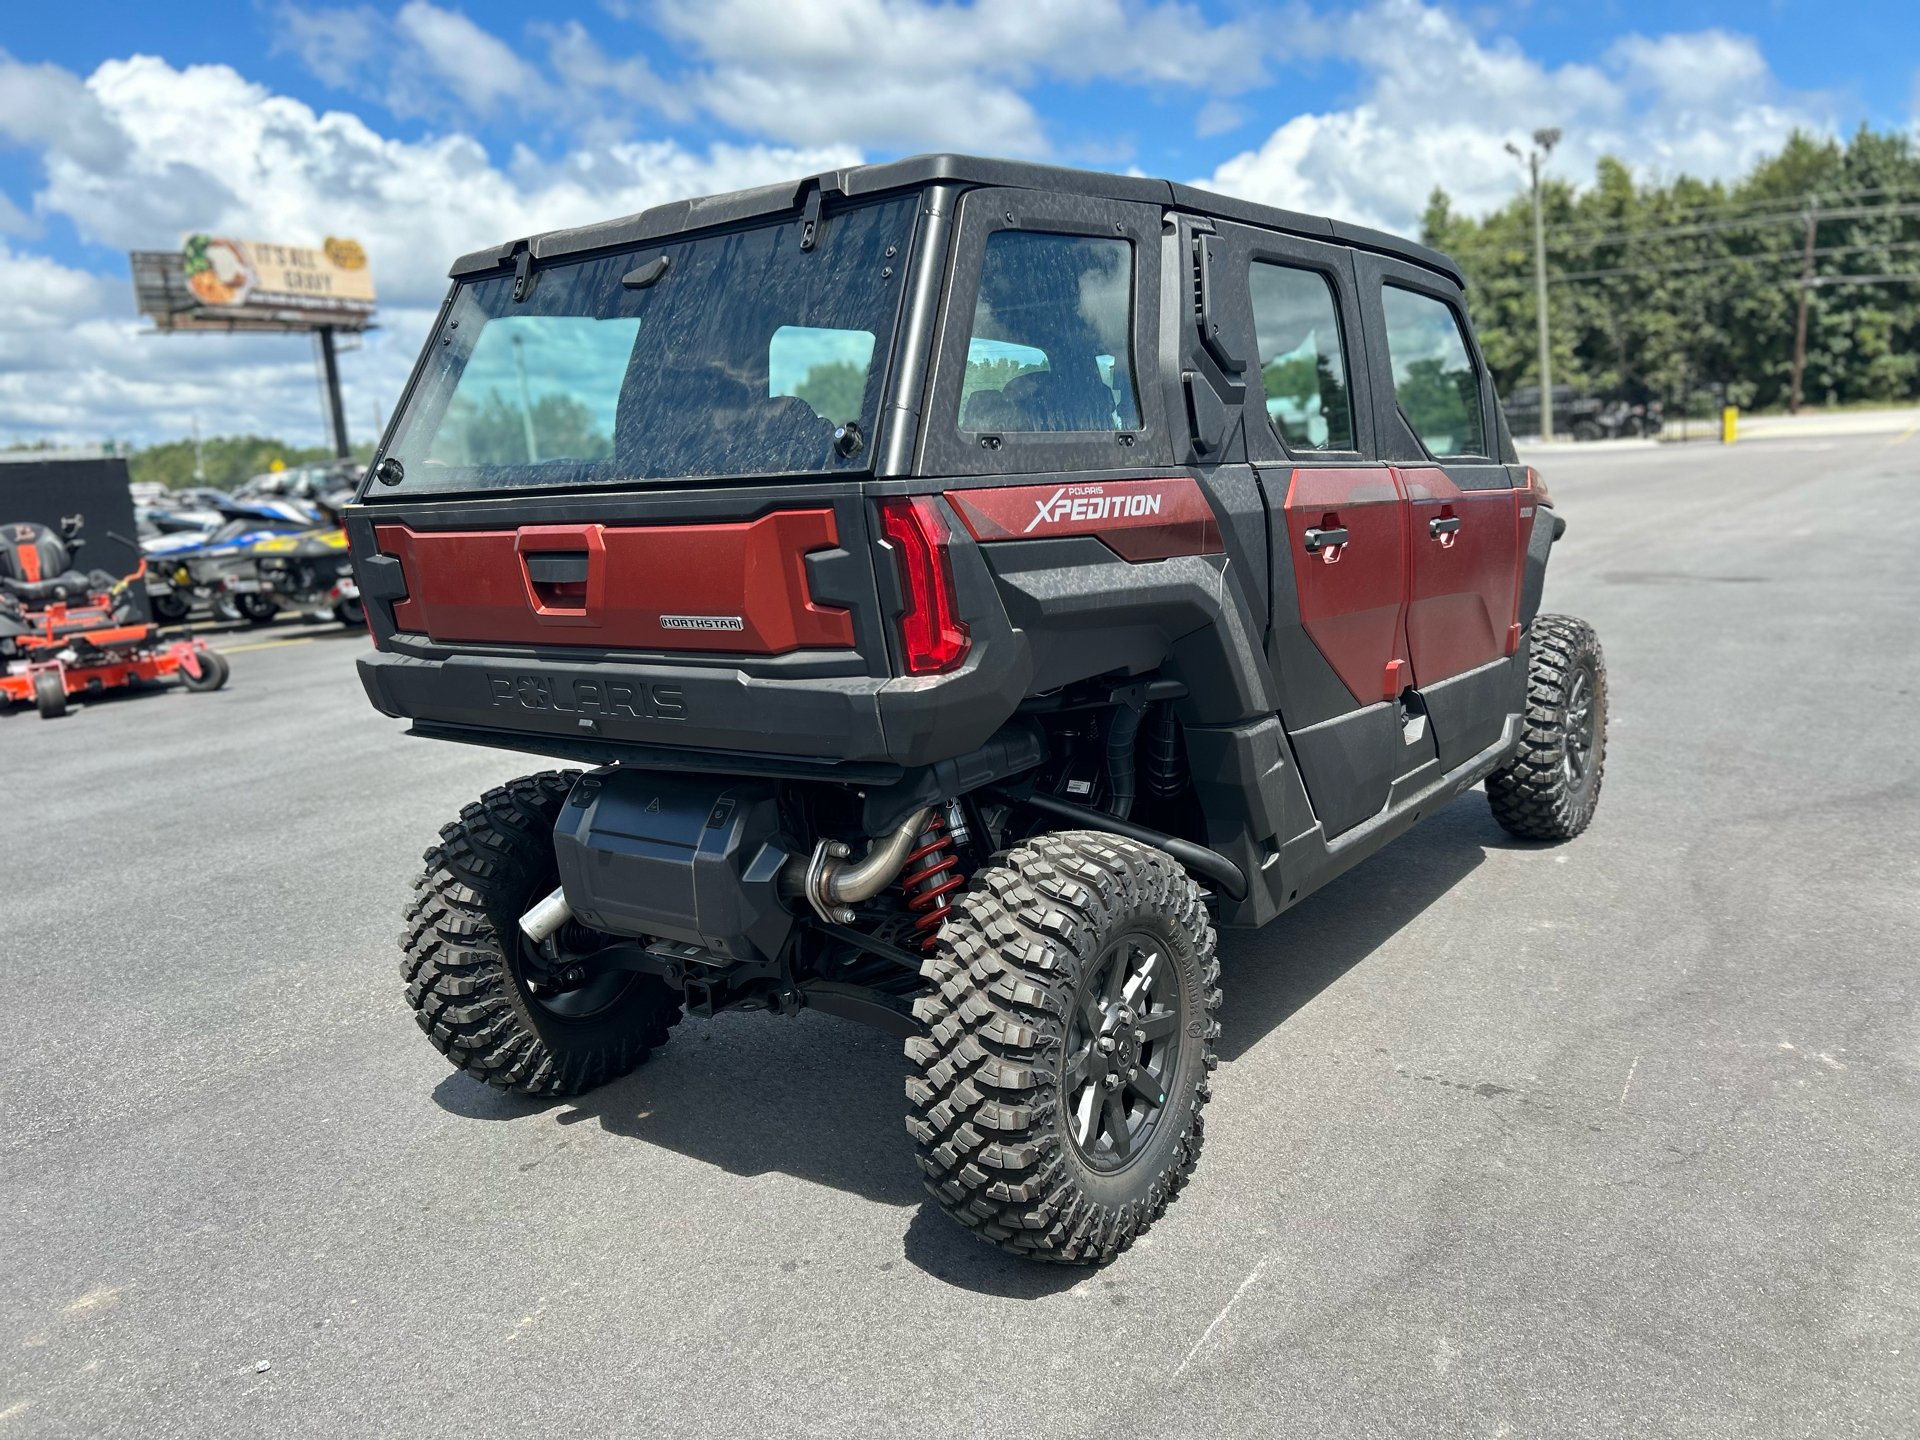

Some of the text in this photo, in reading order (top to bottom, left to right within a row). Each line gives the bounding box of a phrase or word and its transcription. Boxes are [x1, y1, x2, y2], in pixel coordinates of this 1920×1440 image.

[256, 244, 287, 267] IT'S
[290, 249, 318, 270] ALL
[284, 270, 333, 291] GRAVY
[1068, 487, 1104, 496] POLARIS
[1023, 488, 1162, 533] XPEDITION
[1519, 507, 1533, 518] 1000
[662, 618, 739, 629] NORTHSTAR
[486, 673, 689, 721] POLARIS
